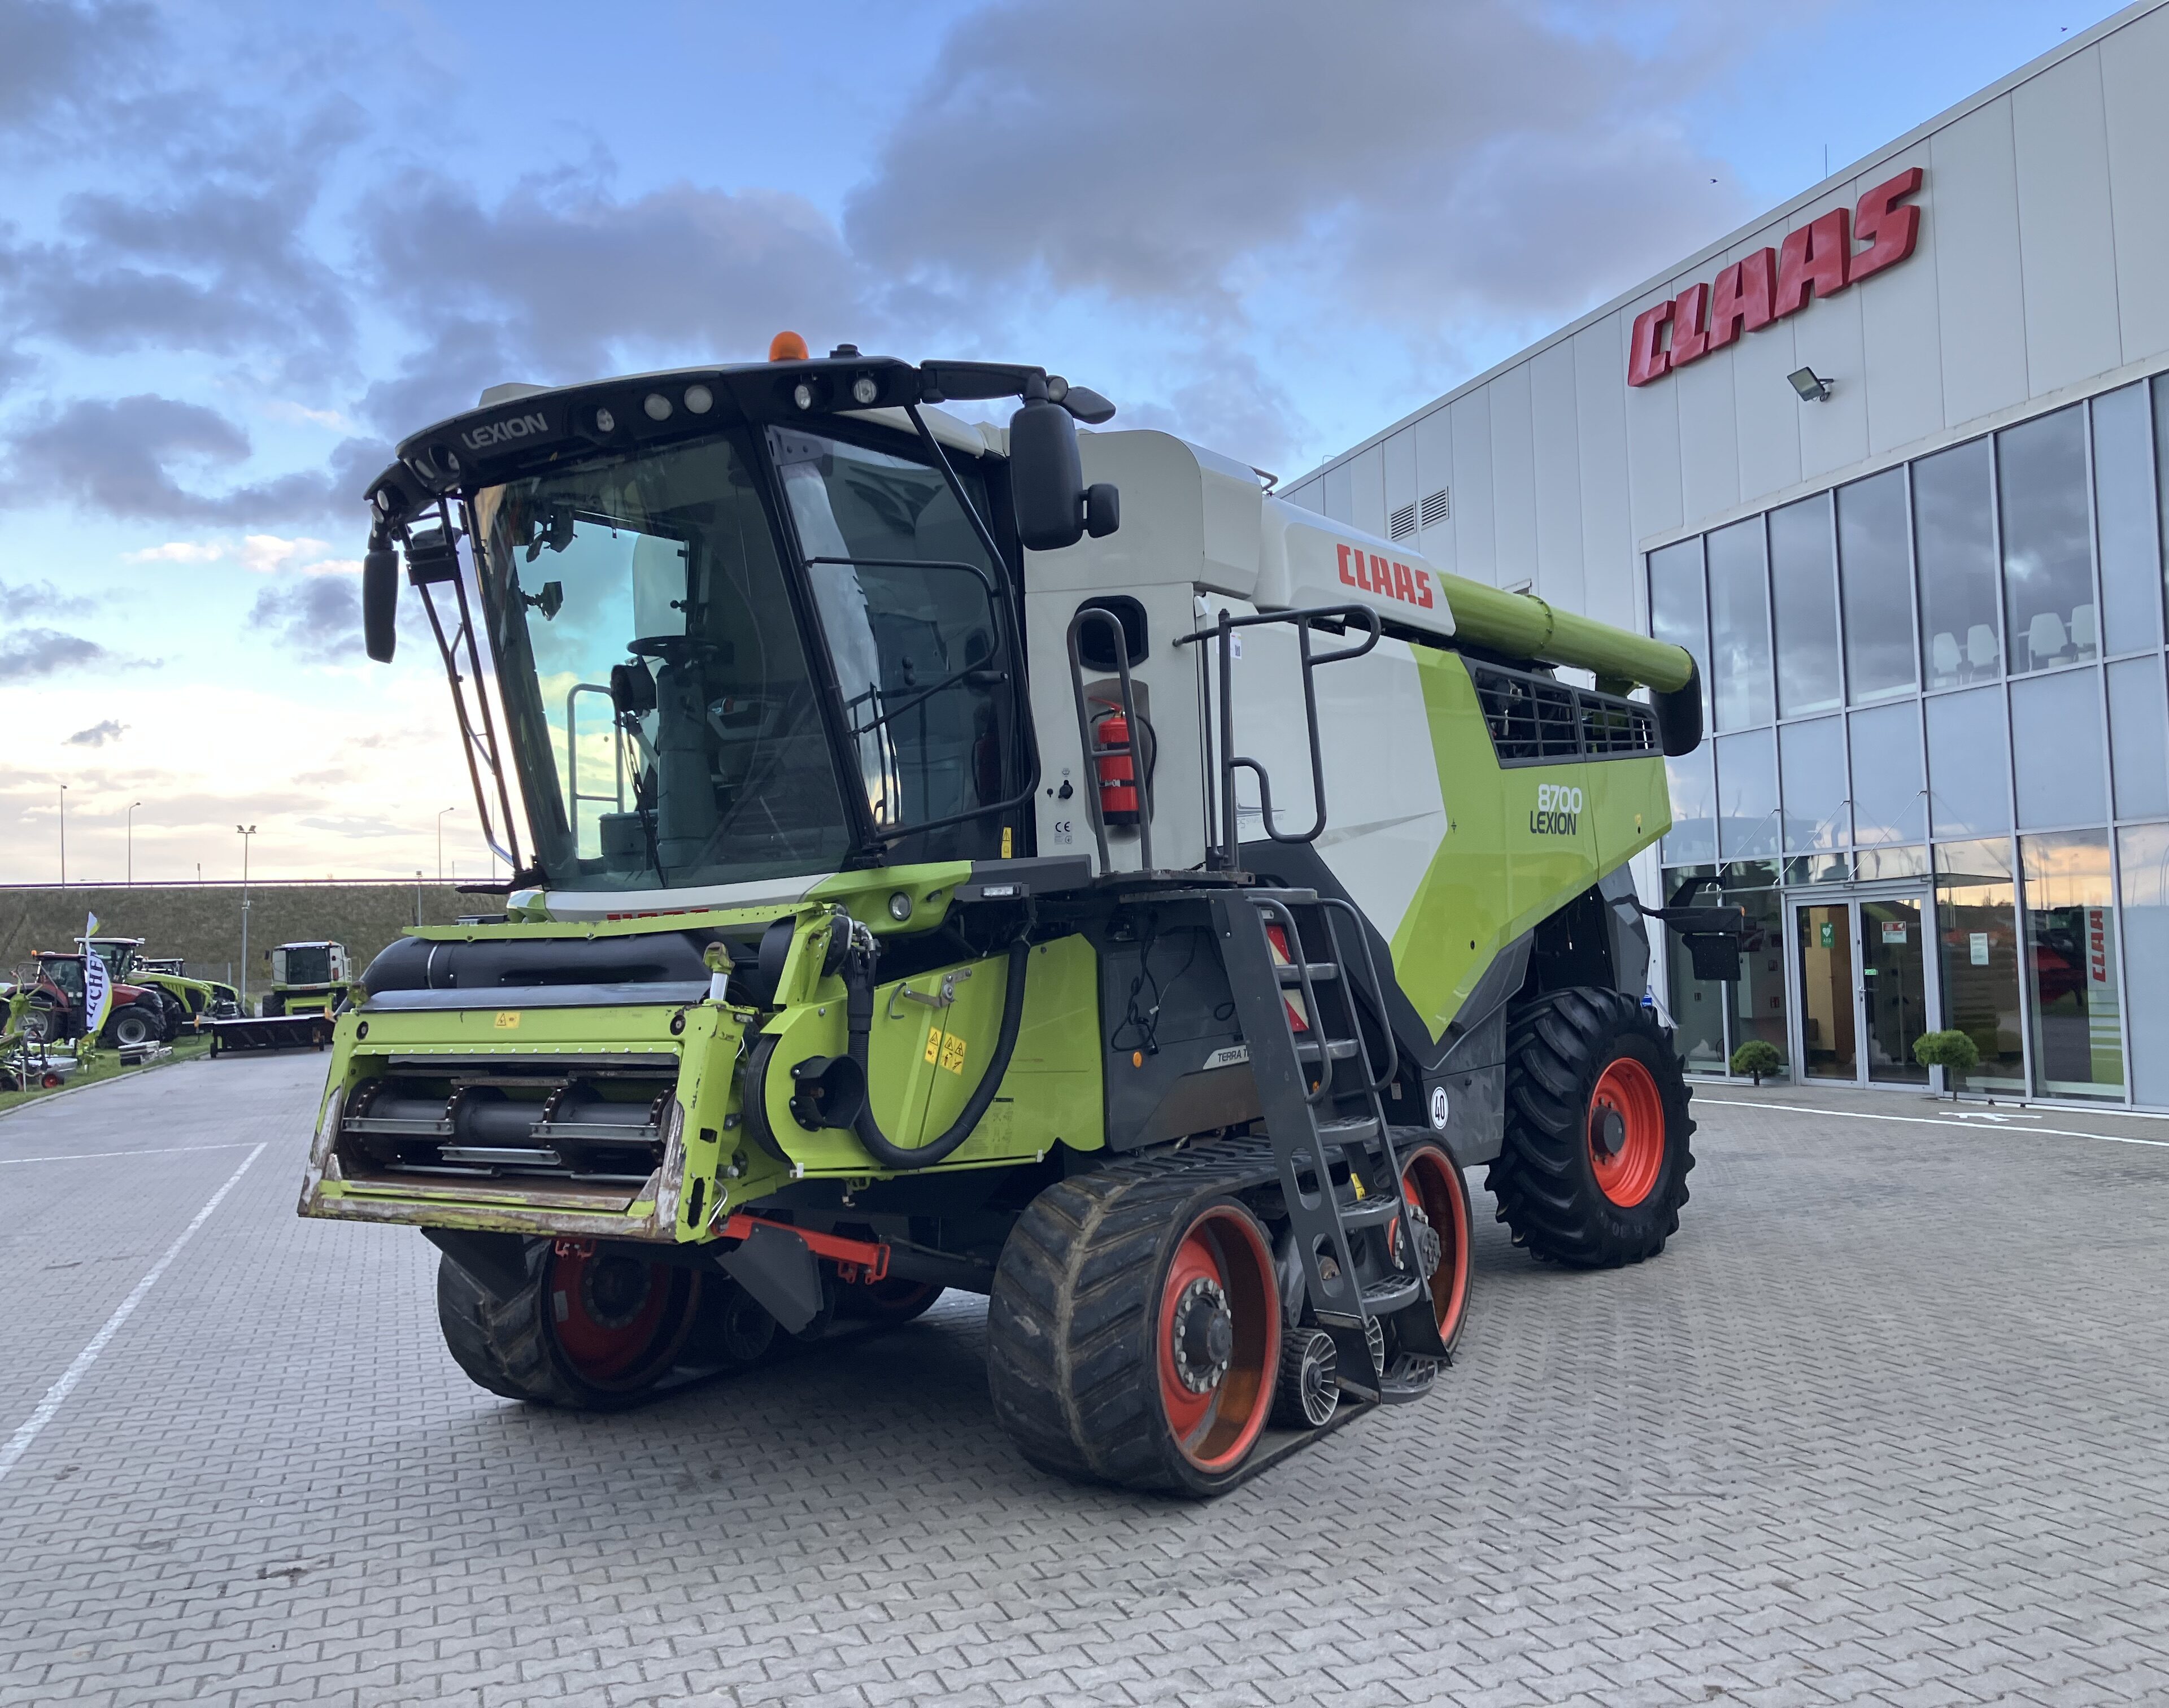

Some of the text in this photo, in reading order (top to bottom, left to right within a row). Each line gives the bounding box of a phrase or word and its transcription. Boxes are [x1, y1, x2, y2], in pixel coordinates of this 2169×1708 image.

[1628, 167, 1923, 387] CLAAS
[461, 412, 549, 450] LEXION
[1336, 543, 1433, 609] CLAAS
[1538, 783, 1582, 814] 8700
[1530, 810, 1576, 835] LEXION
[2089, 898, 2106, 983] CLAA
[1218, 1049, 1242, 1062] TERRA
[1435, 1095, 1445, 1121] 40
